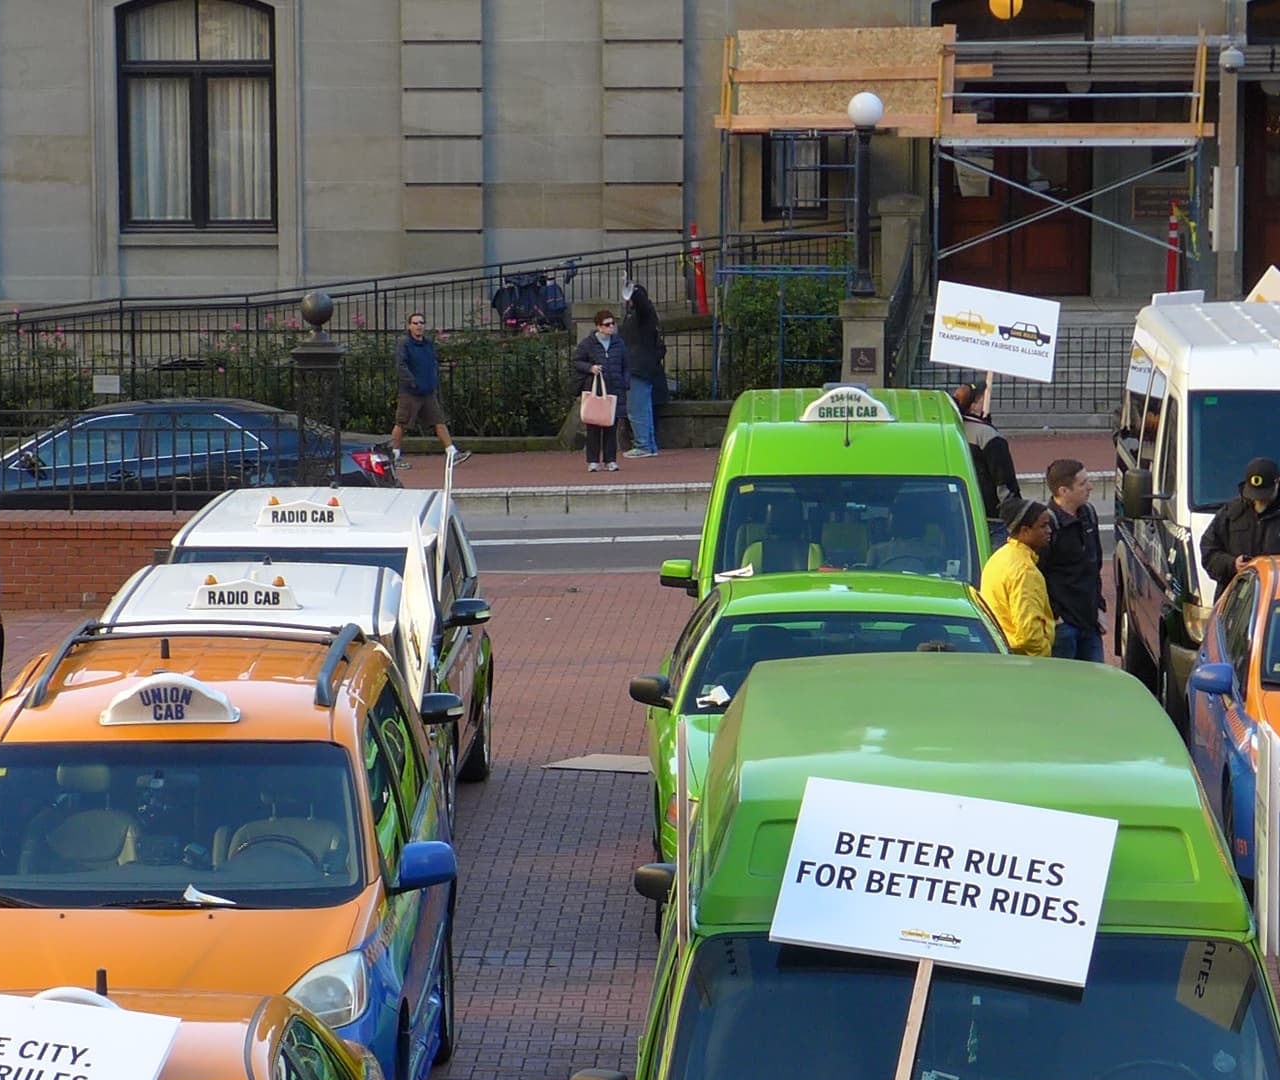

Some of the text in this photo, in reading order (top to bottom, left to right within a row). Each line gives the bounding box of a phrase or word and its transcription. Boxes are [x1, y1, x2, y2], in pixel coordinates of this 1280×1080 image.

[938, 332, 1049, 359] TRANSPORTATION FAIRNESS ALLIANCE
[818, 406, 877, 418] GREEN CAB
[271, 510, 334, 523] RADIO CAB
[207, 590, 280, 605] RADIO CAB
[139, 687, 192, 706] UNION
[152, 704, 184, 721] CAB
[835, 831, 1066, 887] BETTER RULES
[796, 860, 1086, 928] FOR BETTER RIDES.
[18, 1041, 92, 1068] CITY.
